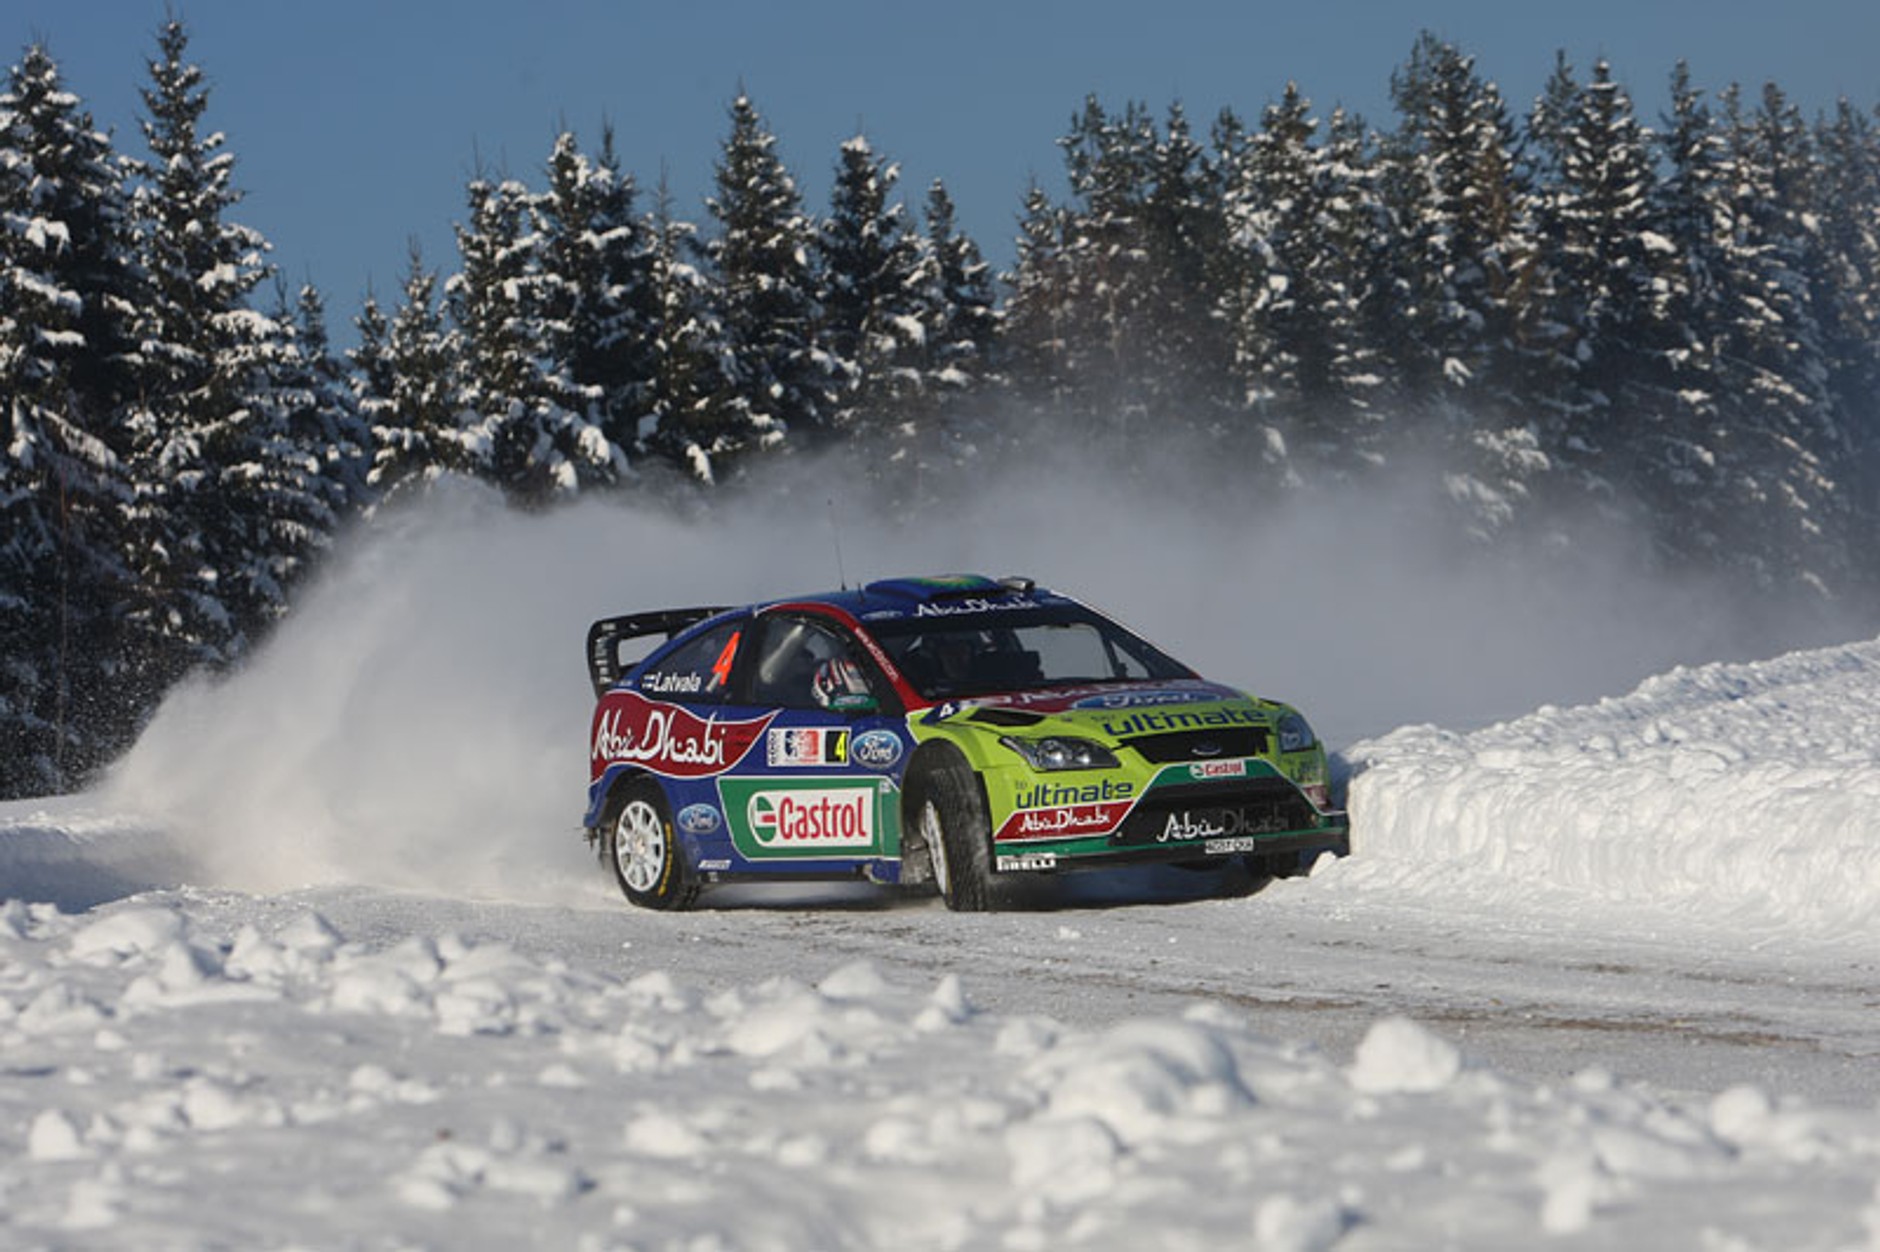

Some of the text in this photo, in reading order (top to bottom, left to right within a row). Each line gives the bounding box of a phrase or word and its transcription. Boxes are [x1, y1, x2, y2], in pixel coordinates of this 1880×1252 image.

[711, 630, 741, 685] 4
[653, 671, 702, 692] Latvala
[939, 702, 955, 718] 4
[1102, 706, 1269, 737] ultimate
[592, 709, 640, 760] Abu
[639, 708, 726, 765] Dhabi
[834, 731, 848, 763] 4
[1015, 778, 1134, 809] ultimate
[779, 796, 867, 841] Castrol
[1019, 804, 1111, 833] Abu Dhabi
[1156, 811, 1224, 843] Abu
[996, 852, 1057, 872] PIRELLI
